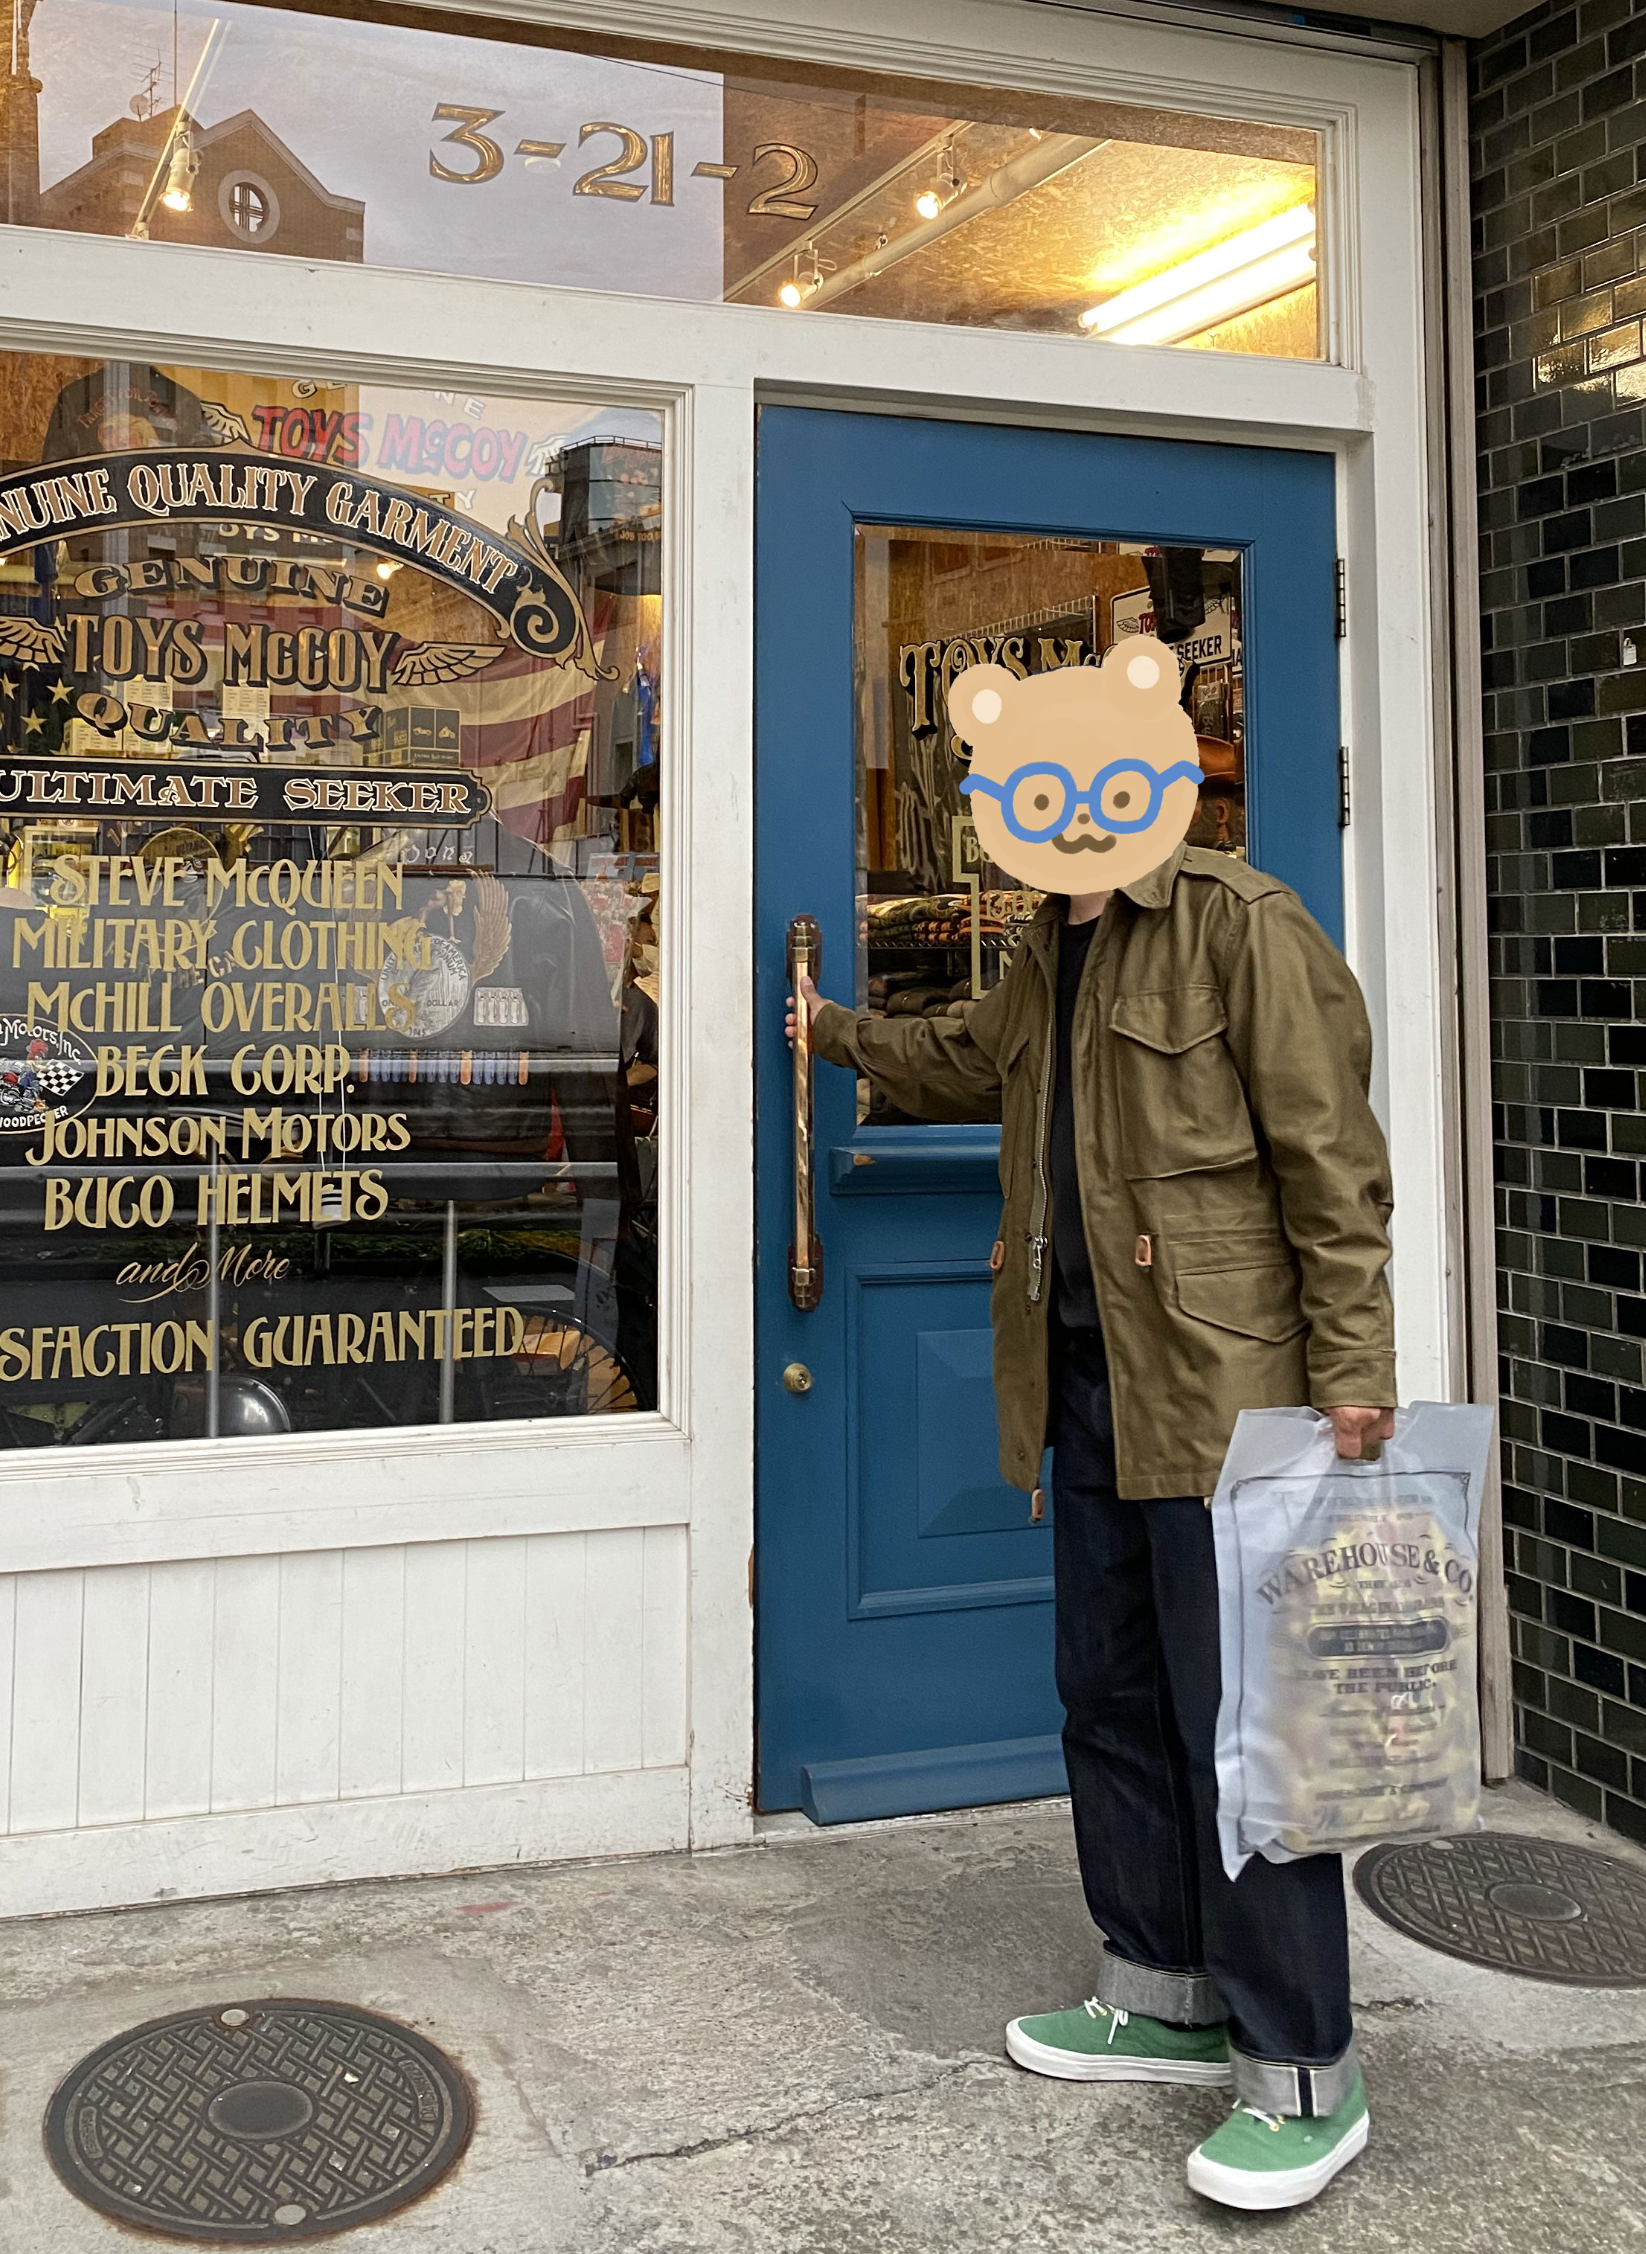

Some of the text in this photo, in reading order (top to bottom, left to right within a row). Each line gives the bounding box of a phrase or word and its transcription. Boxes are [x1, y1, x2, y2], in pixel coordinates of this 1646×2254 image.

[429, 101, 819, 221] 3-21-2
[251, 404, 373, 468] TOYS
[127, 462, 318, 517] QUALITY
[325, 480, 518, 594] GARMENT
[74, 555, 389, 617] GENUINE
[66, 612, 400, 694] TOYS McCOY
[1176, 634, 1222, 661] SEEKER
[77, 692, 383, 753] QUALITY
[0, 769, 471, 813] ULTIMATE SEEKER
[50, 853, 404, 915] STEVE McQUEEN
[12, 917, 218, 972] MILITARY
[232, 920, 433, 970] CLOTHING
[26, 980, 416, 1033] McHILL OVERALLS
[96, 1044, 355, 1097] BECK CORP.
[0, 1105, 69, 1128] OODPECER
[25, 1107, 412, 1167] JOHNSON MOTORS
[197, 1169, 390, 1227] HELMETS
[115, 1242, 291, 1303] and More
[243, 1306, 524, 1369] GUARANTEED
[1256, 1542, 1421, 1606] WAREHOUSE
[1424, 1549, 1440, 1575] &
[1335, 1682, 1368, 1695] THE
